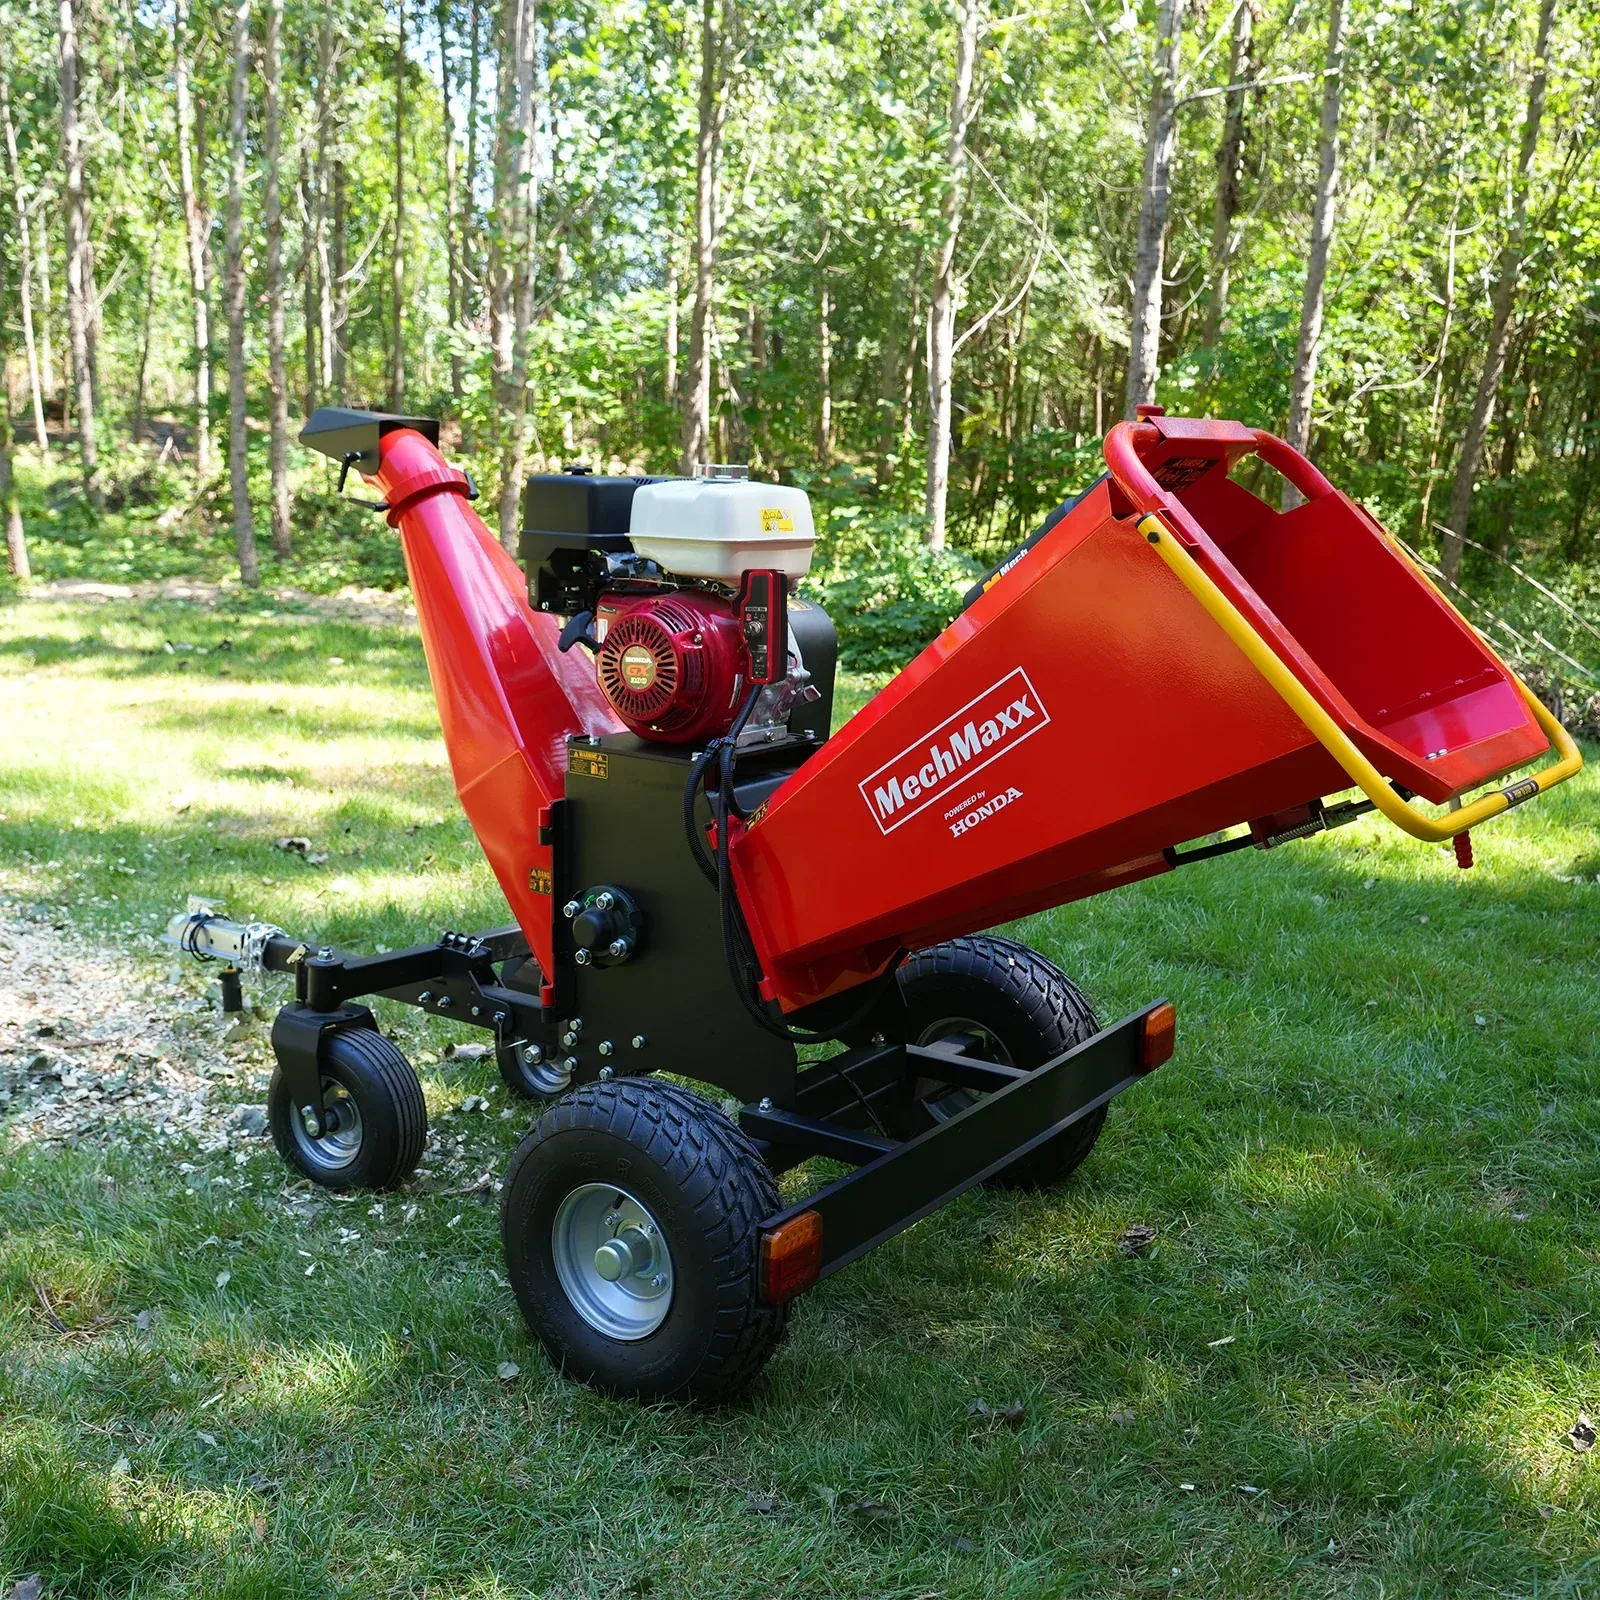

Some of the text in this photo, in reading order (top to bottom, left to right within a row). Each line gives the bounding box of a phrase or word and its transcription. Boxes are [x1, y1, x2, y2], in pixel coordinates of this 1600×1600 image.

[626, 664, 652, 676] GX
[873, 693, 1036, 820] MechMaxx
[944, 790, 986, 820] POWERED by
[949, 786, 1024, 838] HONDA
